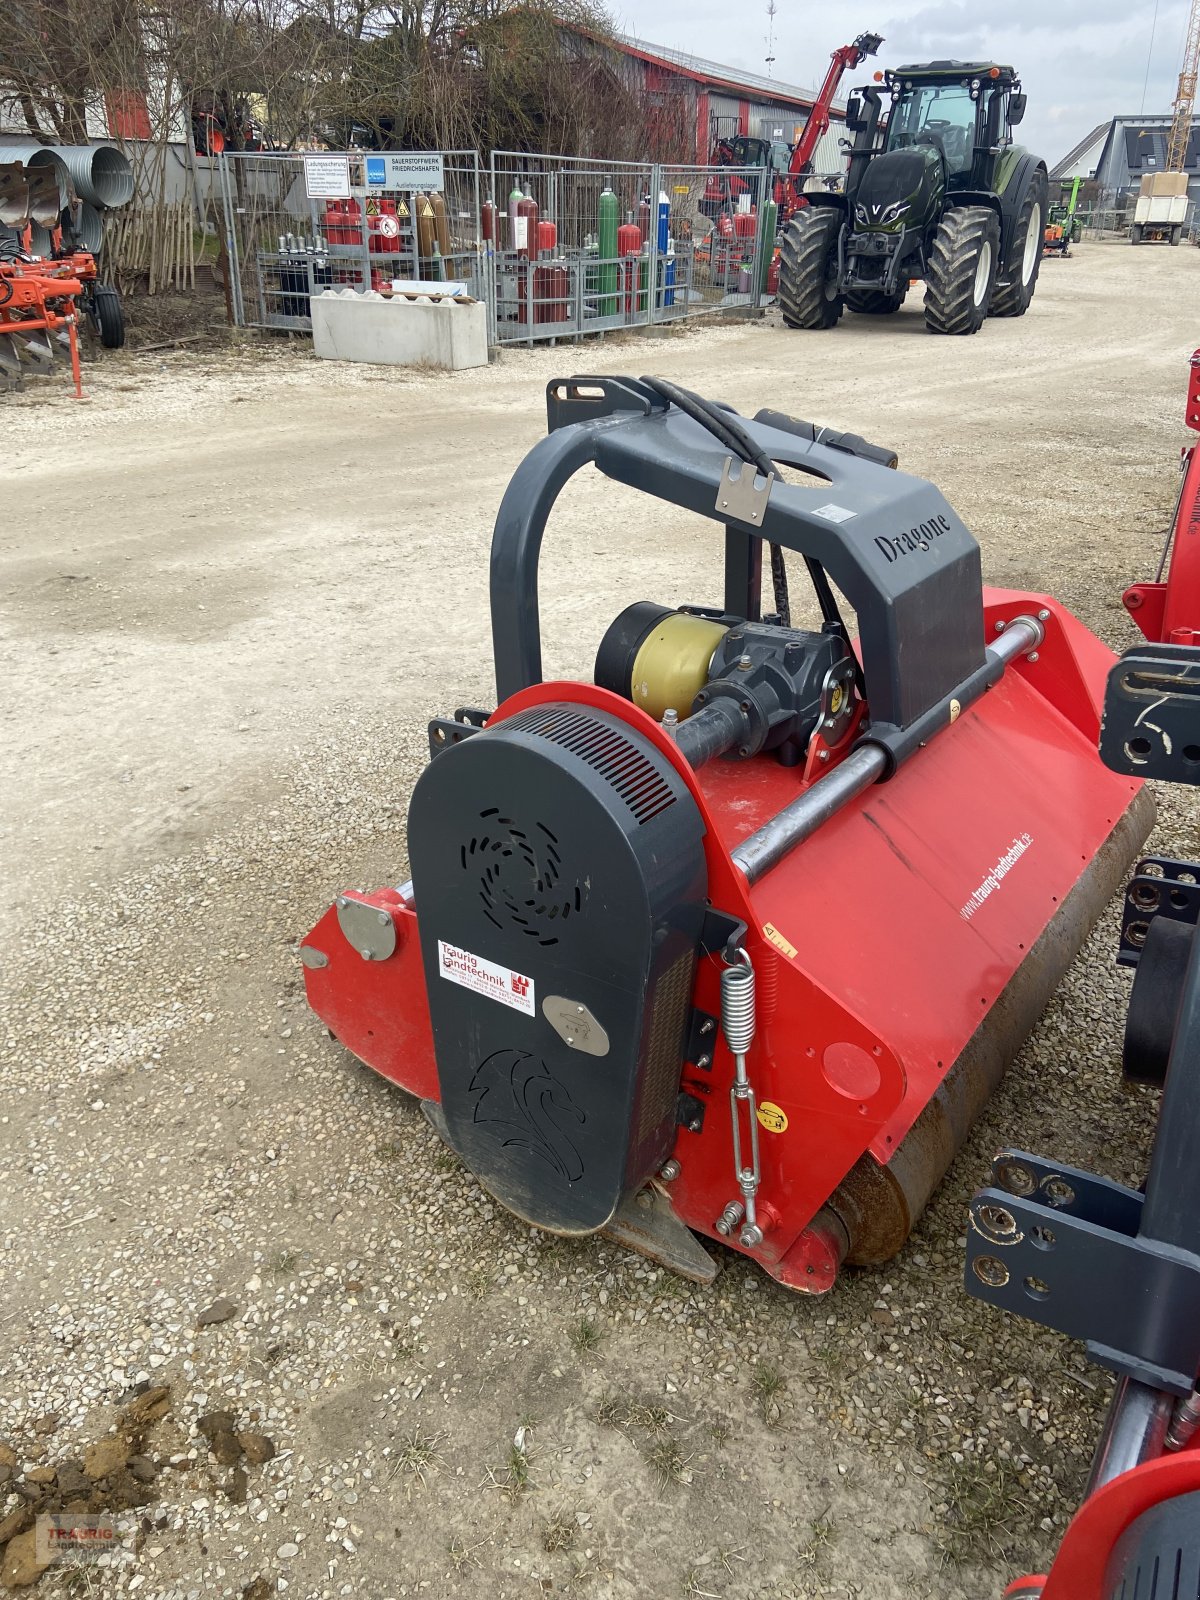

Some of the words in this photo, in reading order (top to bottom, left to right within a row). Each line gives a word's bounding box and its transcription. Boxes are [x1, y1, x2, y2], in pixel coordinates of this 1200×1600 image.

[873, 514, 951, 563] Dragone
[959, 832, 1034, 920] www.traurig-landtechnik.de
[441, 943, 477, 968] Traurig
[442, 952, 504, 989] Landtechnik
